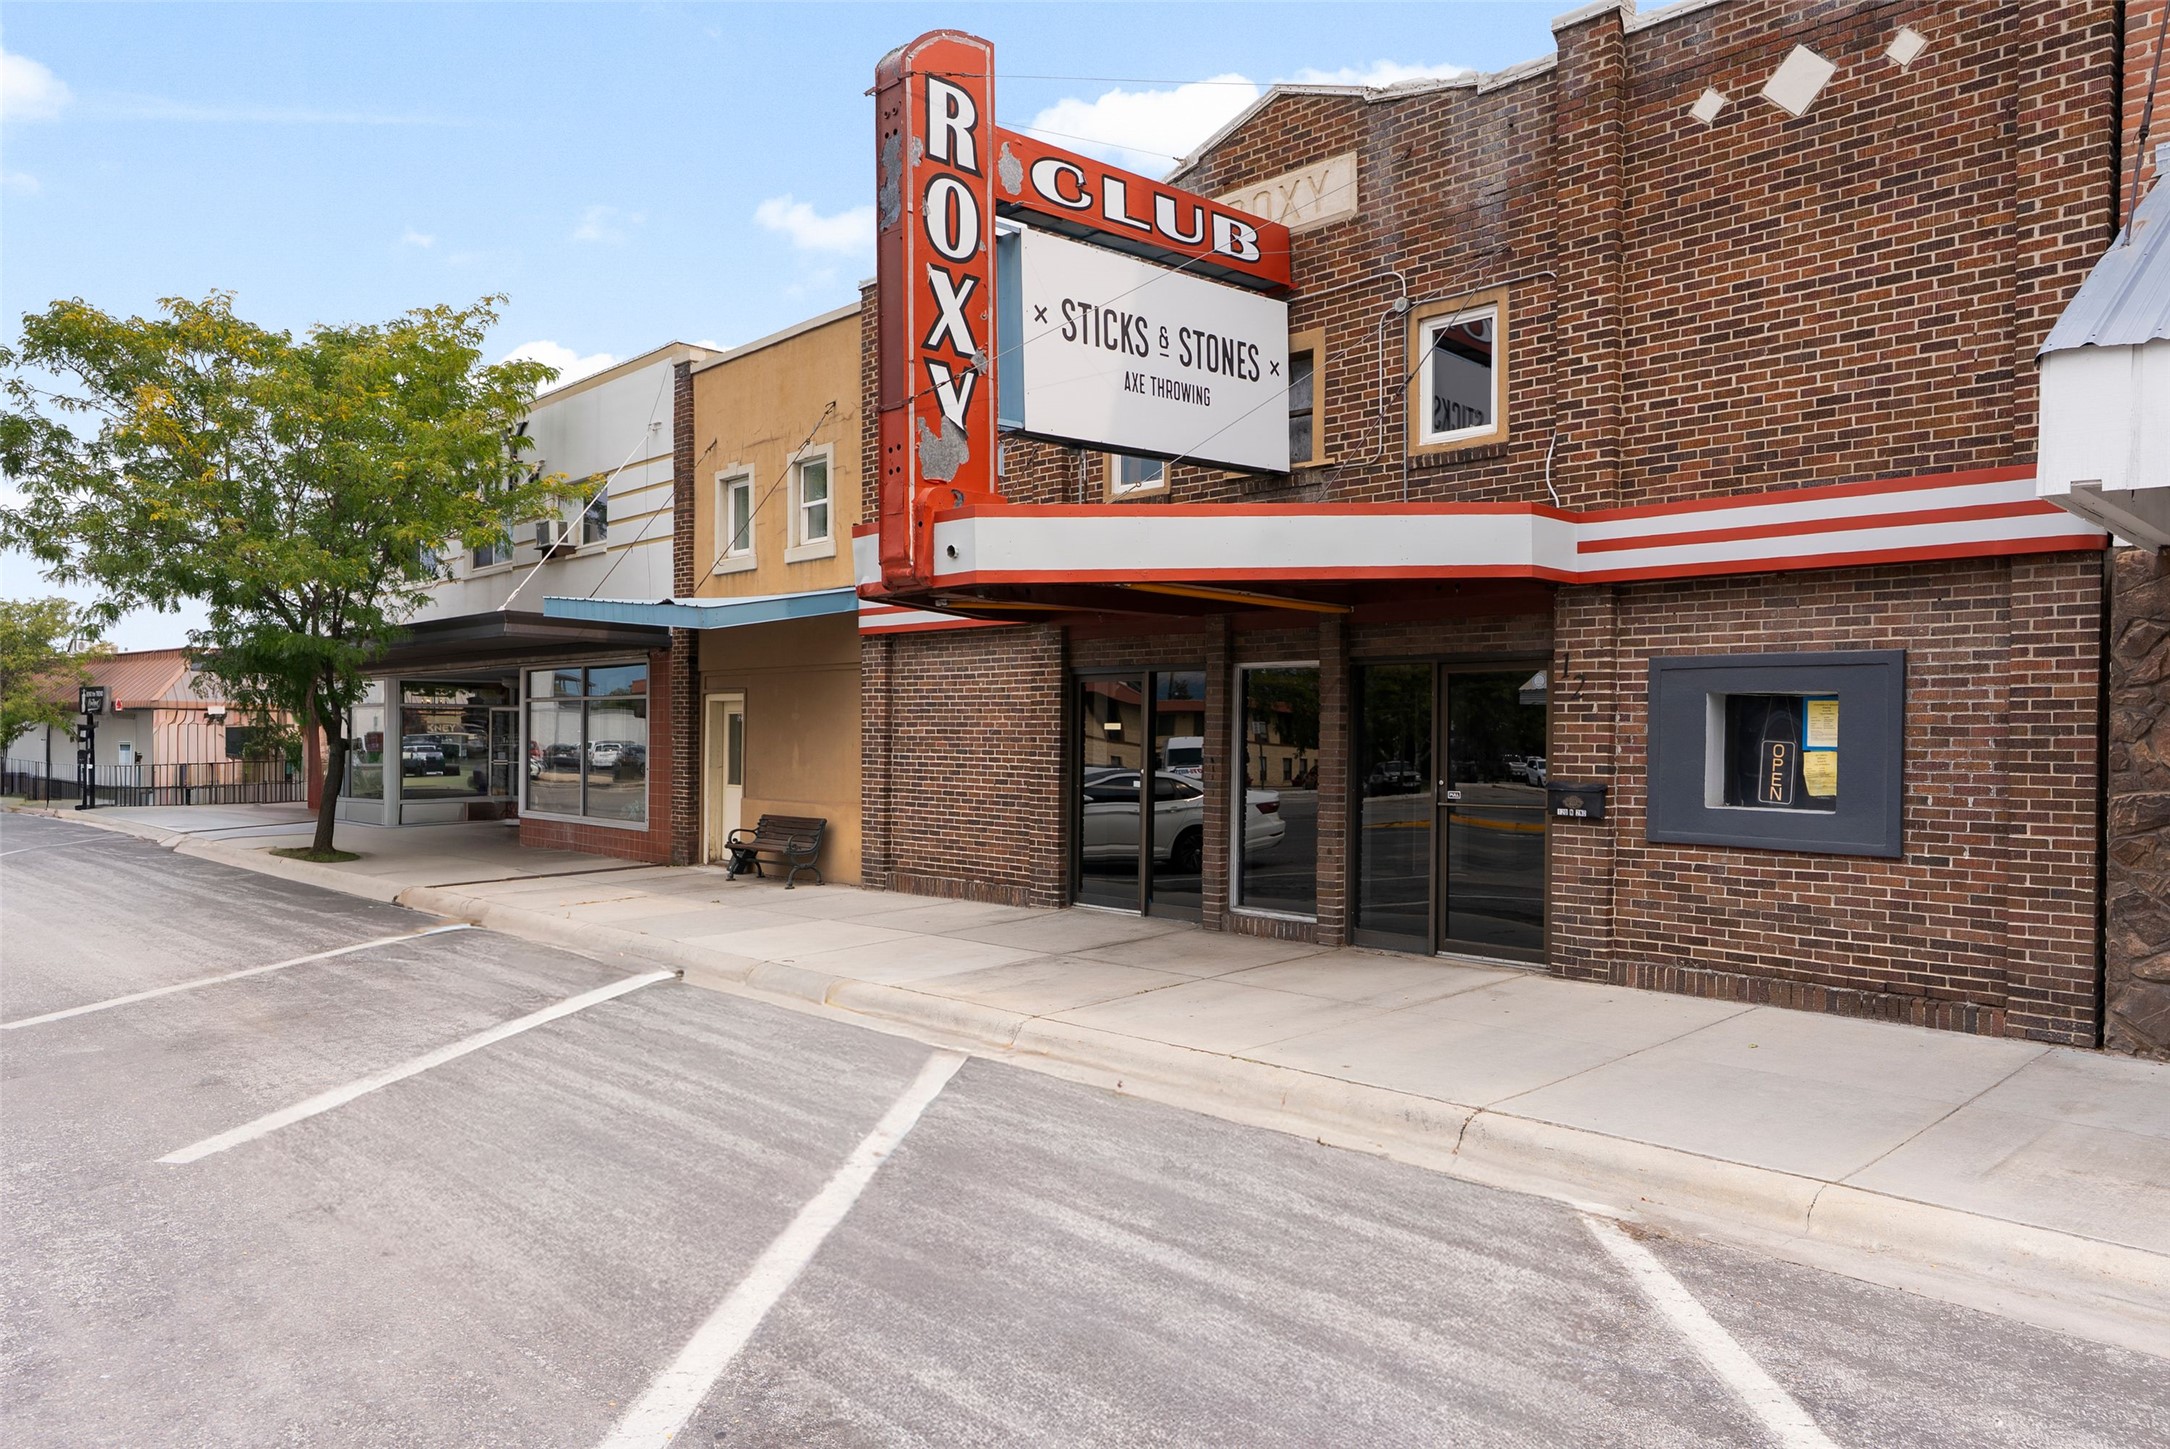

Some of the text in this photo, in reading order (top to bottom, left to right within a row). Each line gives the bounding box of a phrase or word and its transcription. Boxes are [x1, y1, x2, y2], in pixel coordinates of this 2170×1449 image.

[1029, 156, 1261, 263] CLUB
[922, 74, 984, 440] ROXY
[1061, 298, 1260, 382] STICKS & STONES
[1124, 371, 1211, 407] AXE THROWING
[1770, 744, 1785, 801] OPEN
